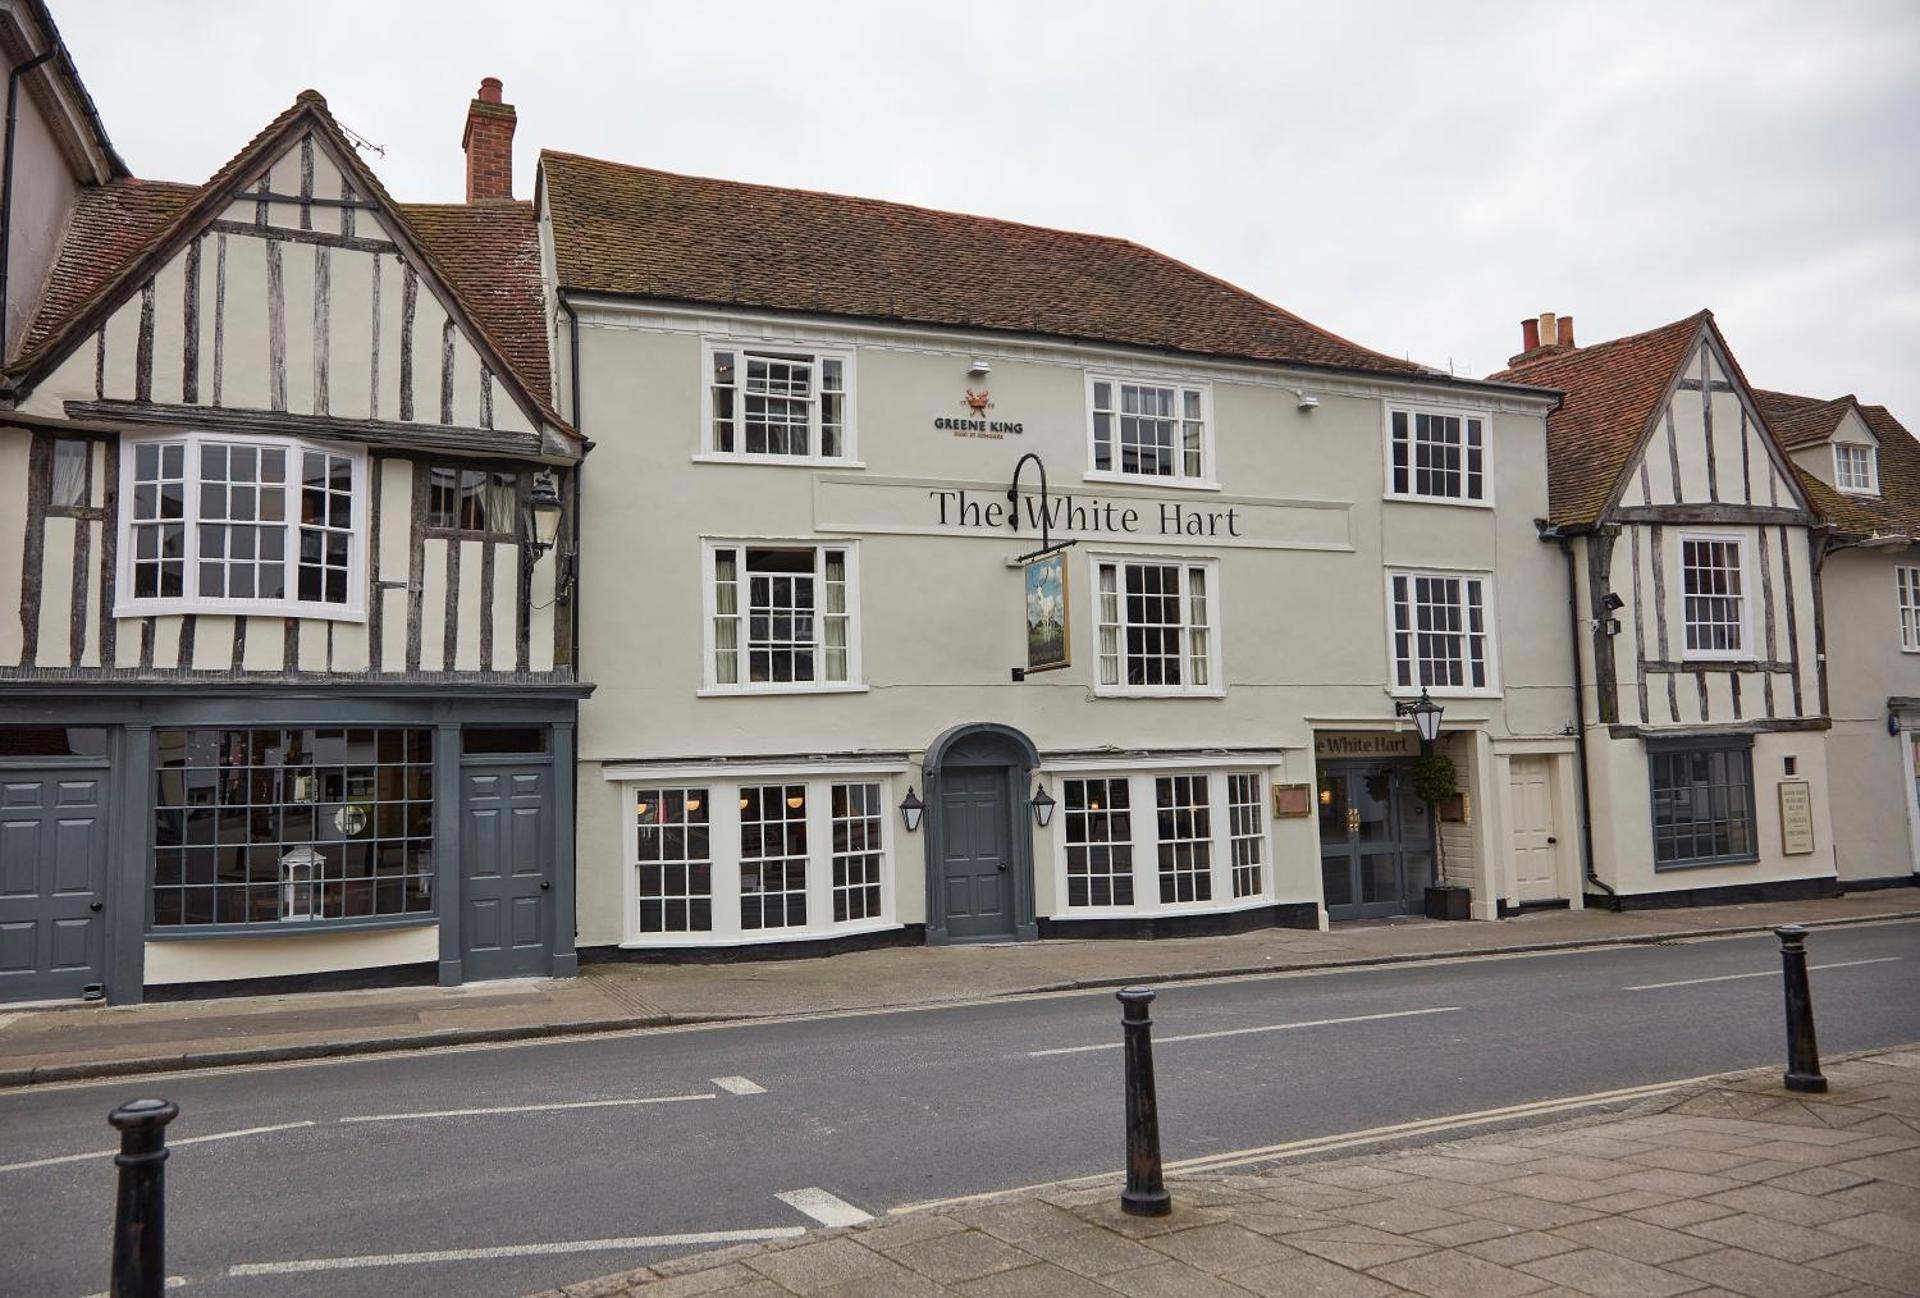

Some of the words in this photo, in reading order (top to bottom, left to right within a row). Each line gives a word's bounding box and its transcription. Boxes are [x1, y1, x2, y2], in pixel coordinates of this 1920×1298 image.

[934, 417, 986, 432] GREENE
[990, 421, 1024, 435] KING
[930, 491, 1003, 528] The
[1025, 496, 1139, 532] White
[1158, 503, 1242, 537] Hart
[1327, 736, 1372, 753] White
[1375, 736, 1408, 753] Hart
